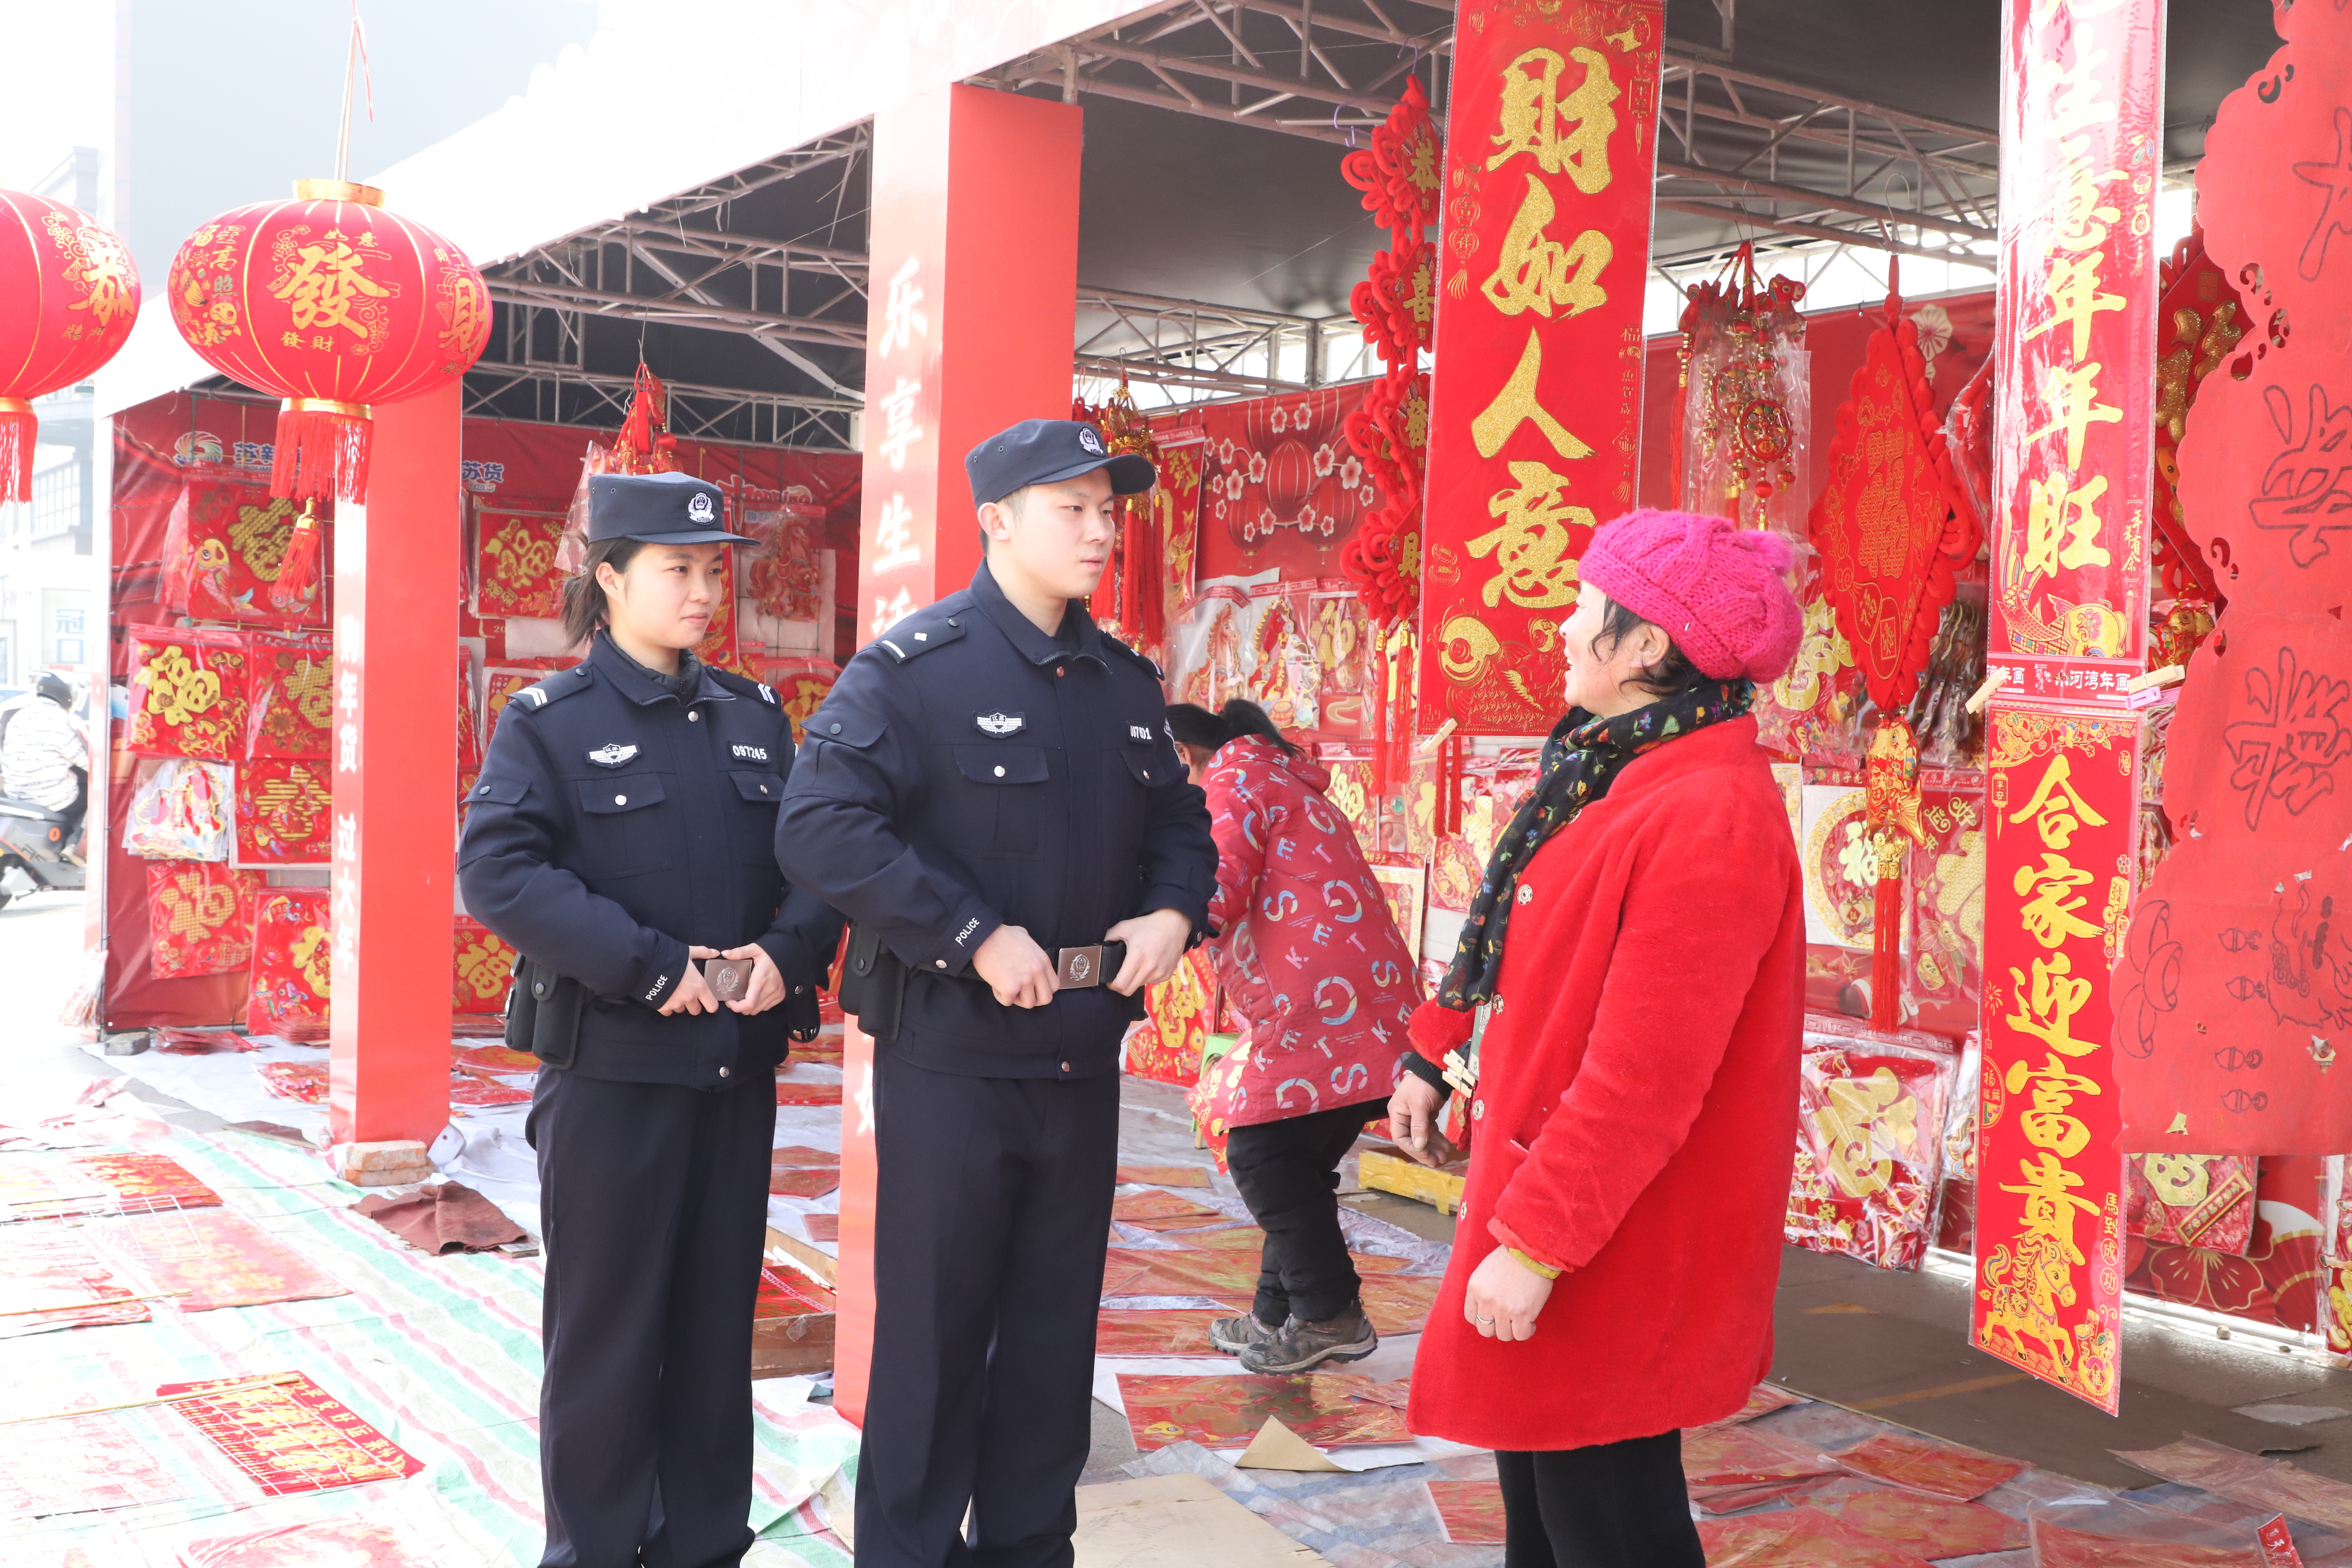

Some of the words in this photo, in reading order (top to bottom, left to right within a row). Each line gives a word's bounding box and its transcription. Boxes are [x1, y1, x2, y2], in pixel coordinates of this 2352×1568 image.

[273, 243, 390, 338] 發
[1465, 46, 1622, 608] 財如人意
[2021, 0, 2130, 579] 生意年年旺
[280, 331, 336, 354] 發財
[462, 461, 504, 483] 苏货
[1856, 425, 1912, 579] 福
[732, 745, 767, 760] 097245
[1996, 780, 2005, 800] 平安
[336, 814, 357, 971] 过大年
[955, 917, 980, 947] POLICE
[645, 974, 668, 1001] POLICE
[1998, 753, 2109, 1266] 合家迎富貴
[2102, 1192, 2120, 1293] 馬到成功
